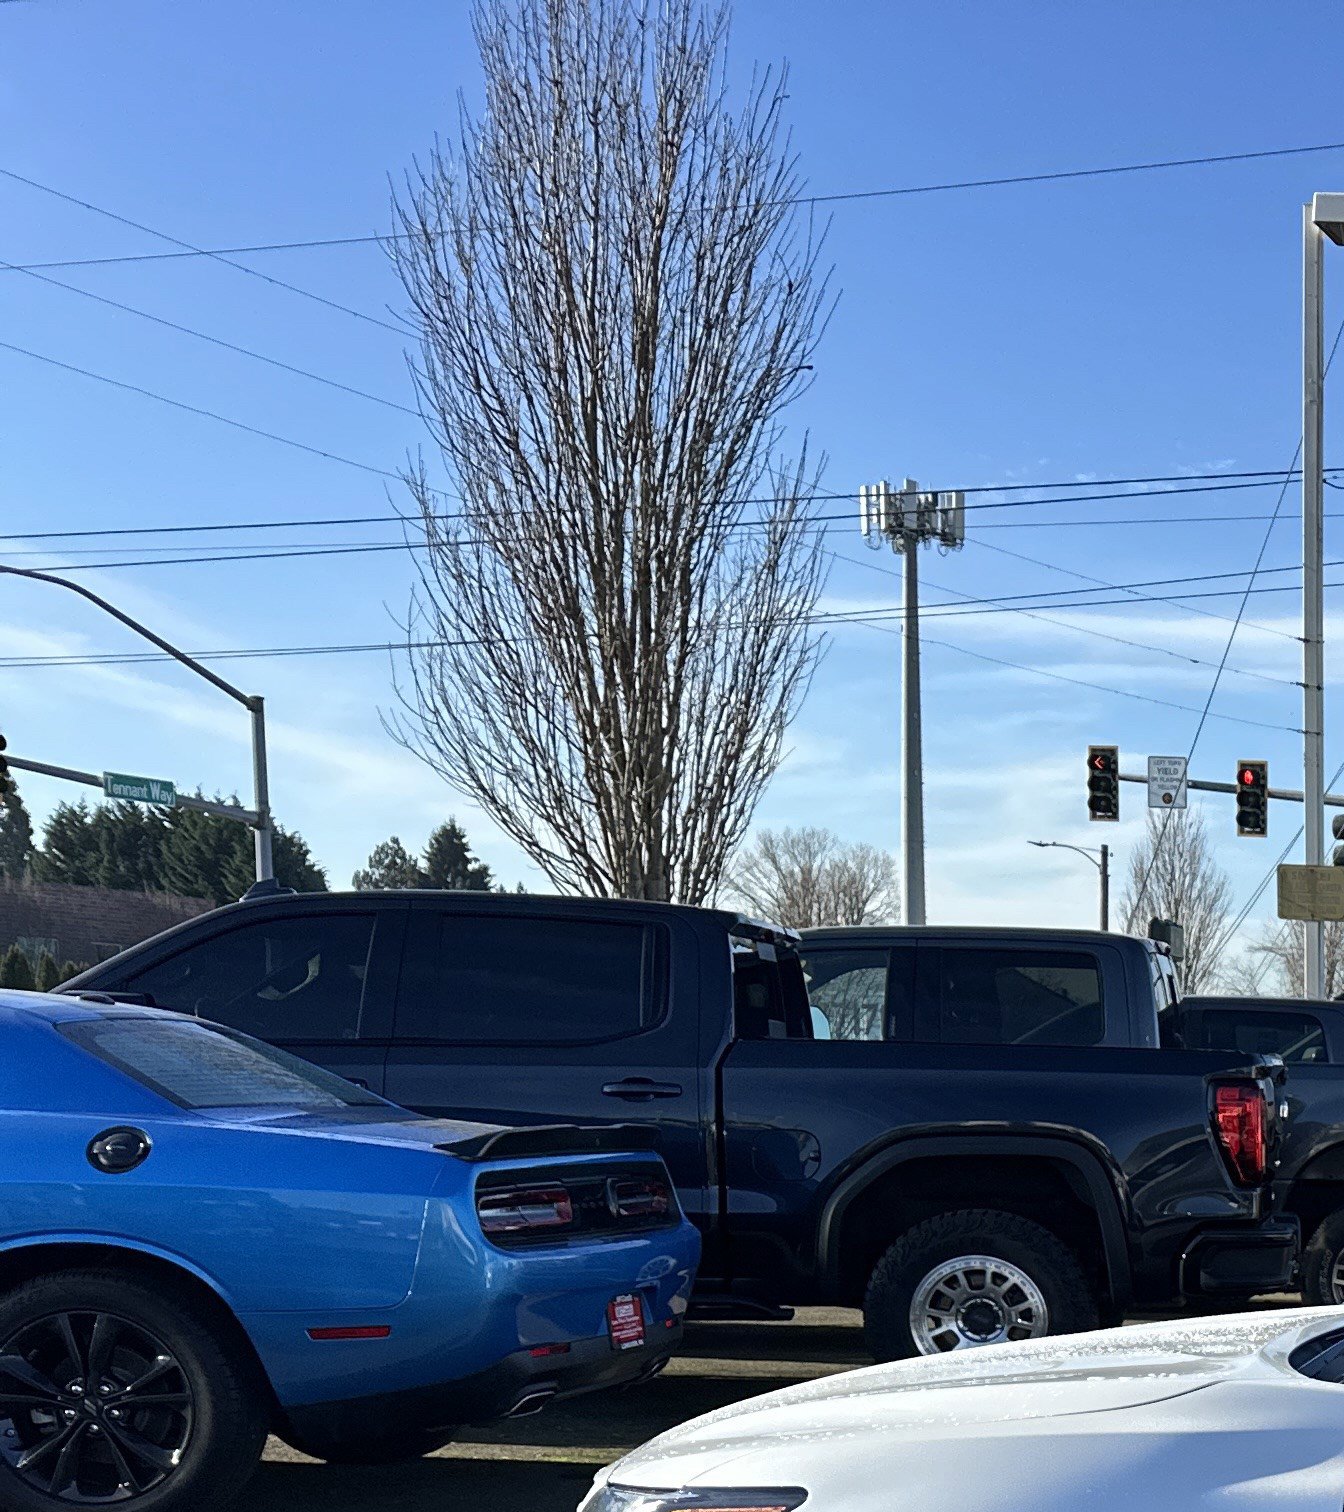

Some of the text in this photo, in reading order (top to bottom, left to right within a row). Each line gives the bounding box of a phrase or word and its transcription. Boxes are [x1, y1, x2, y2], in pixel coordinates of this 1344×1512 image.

[1157, 767, 1179, 775] YIELD
[105, 775, 174, 805] Tennant Way
